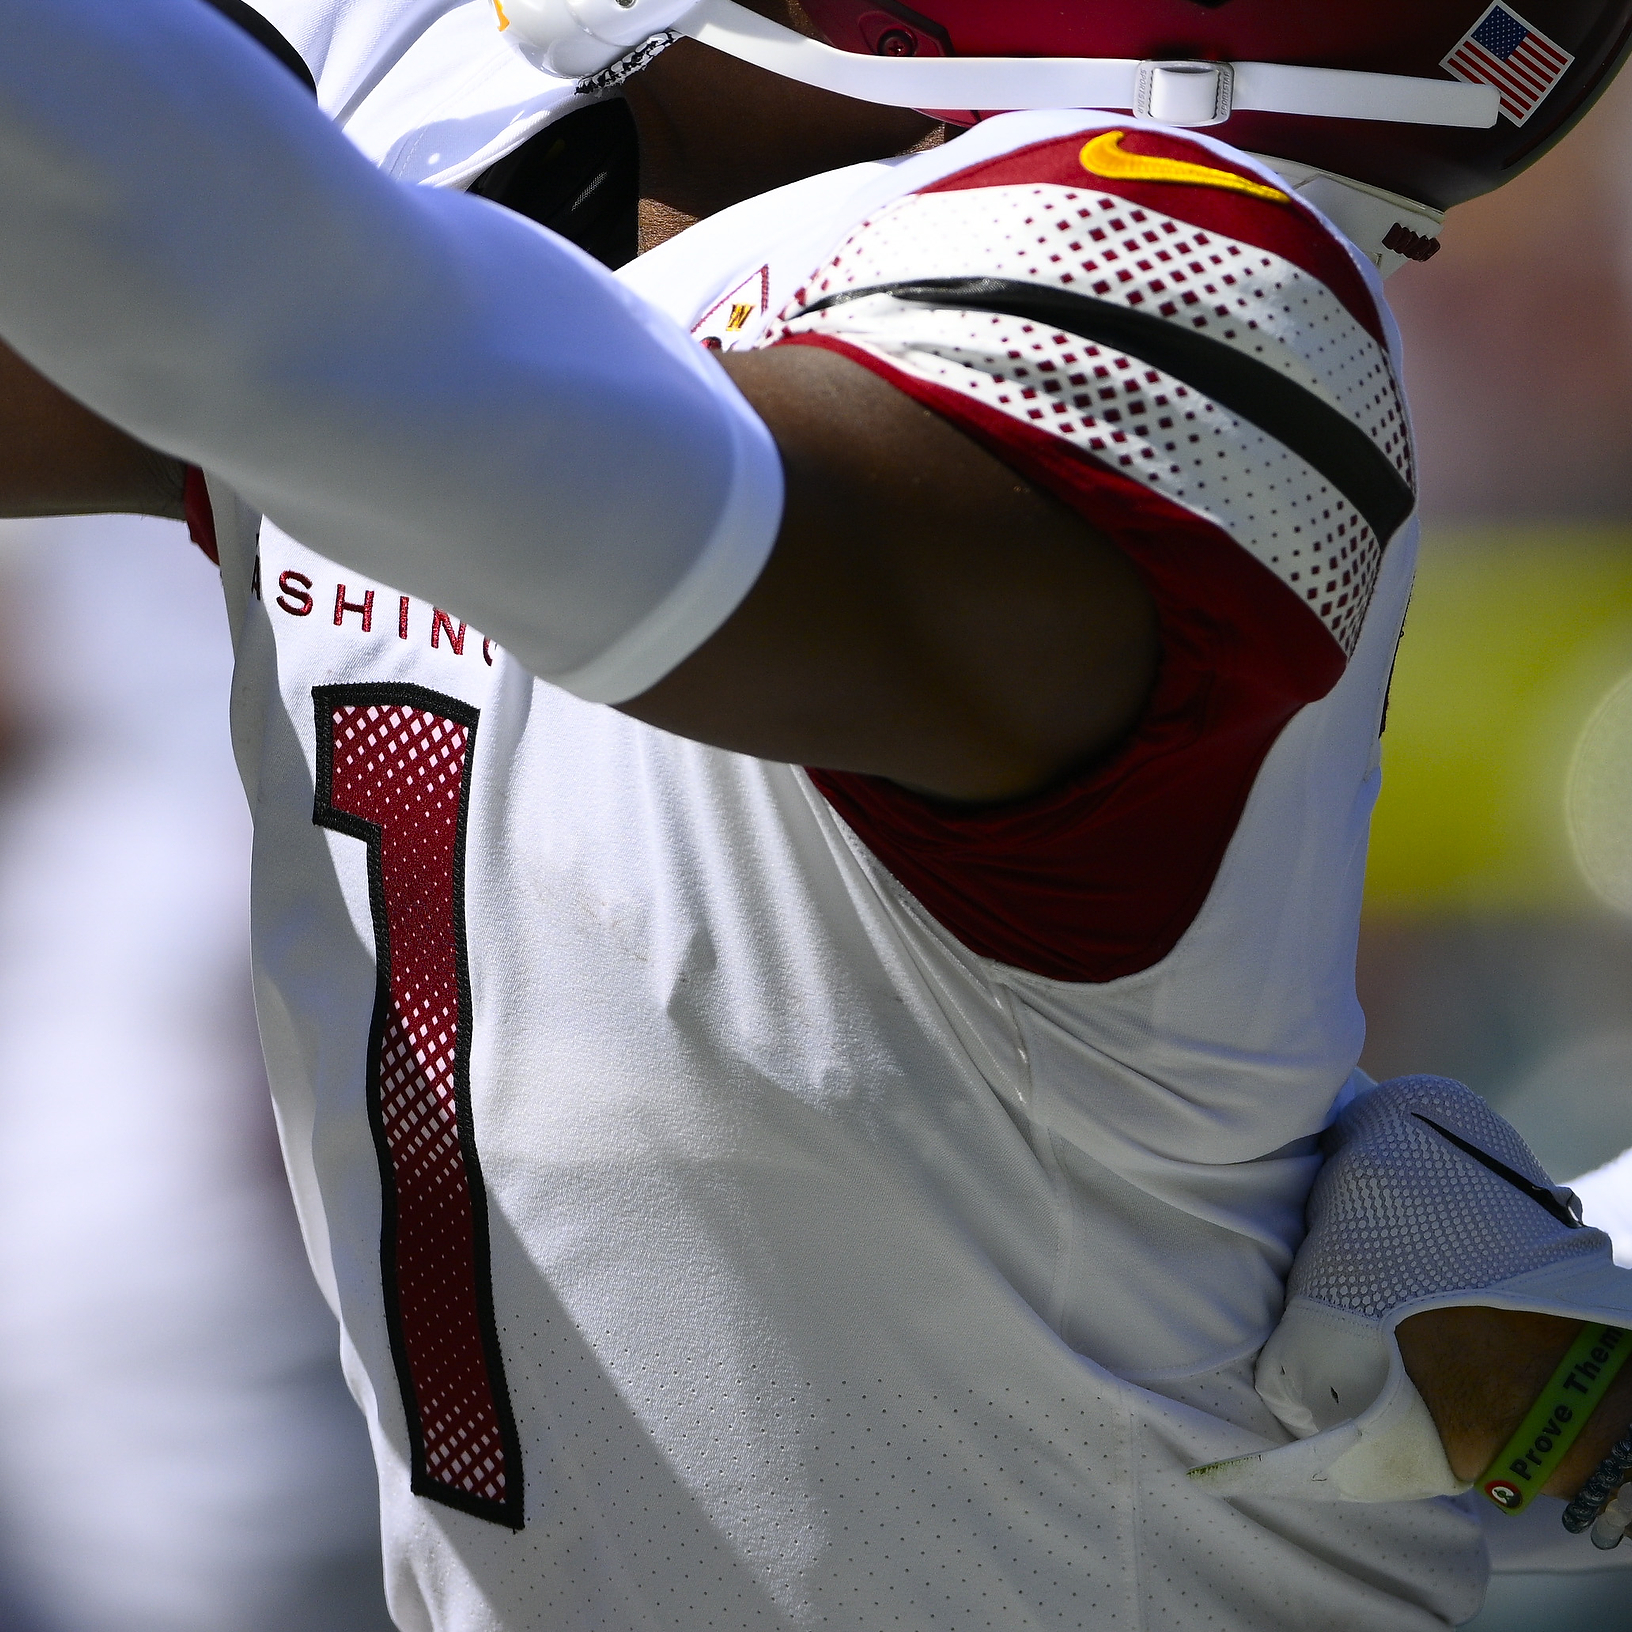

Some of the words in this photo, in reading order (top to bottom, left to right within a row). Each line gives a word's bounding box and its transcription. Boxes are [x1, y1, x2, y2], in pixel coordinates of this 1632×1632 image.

[1137, 68, 1148, 114] SPORTSTAR
[312, 681, 525, 1534] 1
[1508, 1403, 1573, 1481] Prove
[1563, 1325, 1624, 1395] Them
